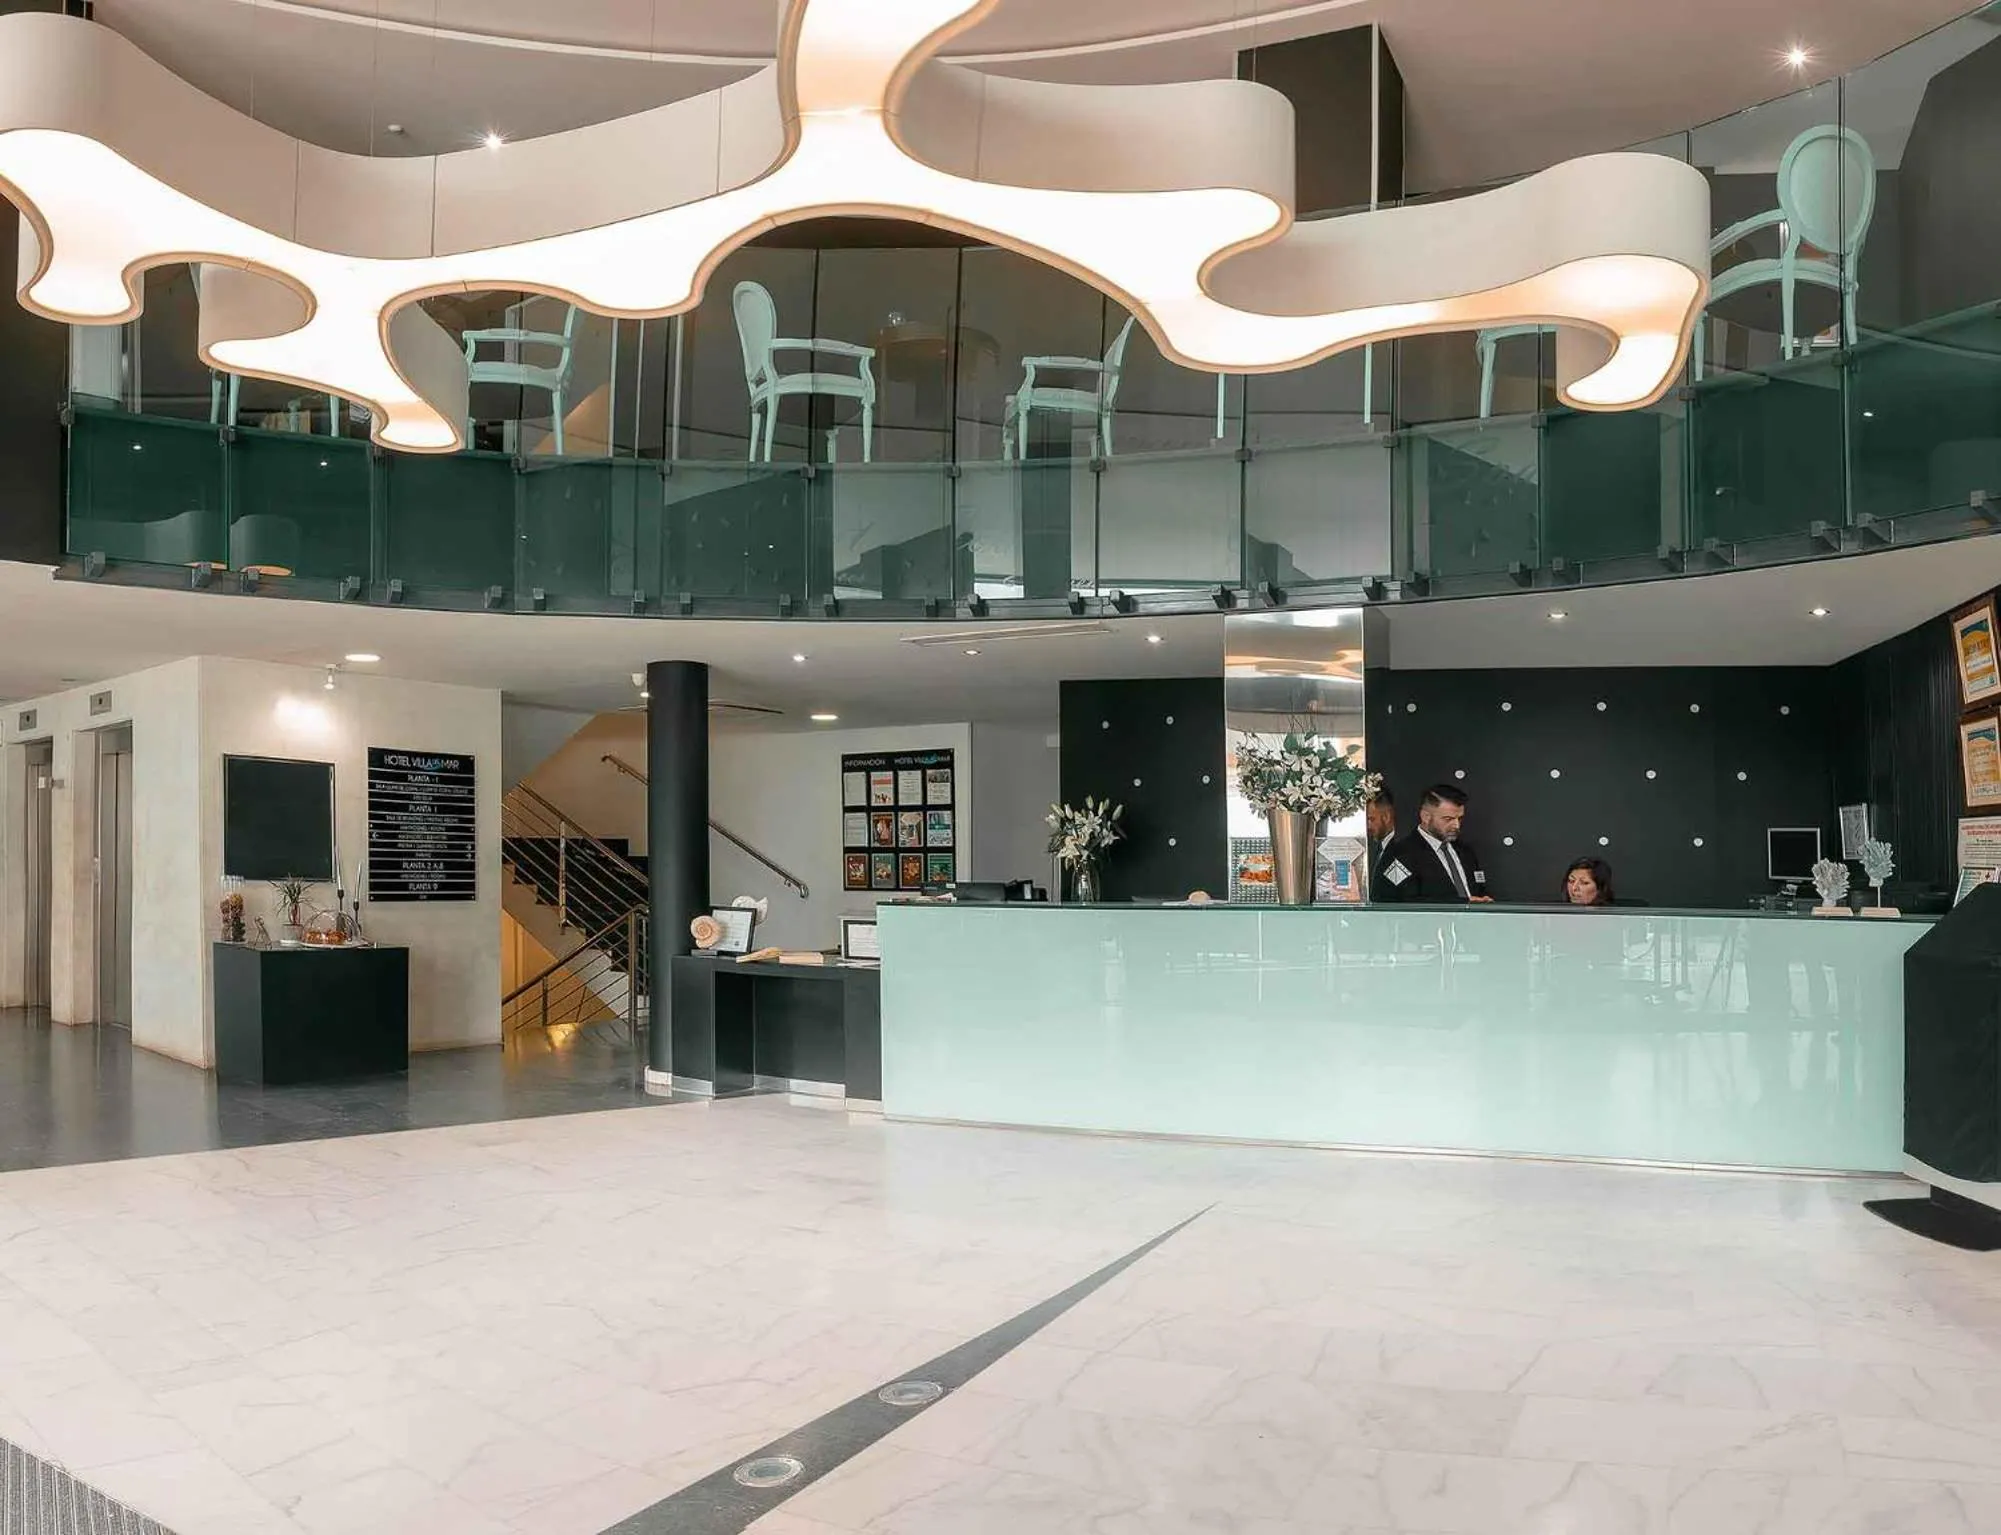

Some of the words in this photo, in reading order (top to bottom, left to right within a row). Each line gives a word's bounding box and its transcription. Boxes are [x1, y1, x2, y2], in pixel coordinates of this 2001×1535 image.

[384, 755, 411, 767] HOTEL
[411, 757, 433, 768] VILLA
[441, 759, 459, 769] MAR
[408, 774, 430, 783] PLANTA
[409, 804, 432, 813] PLANTA
[409, 882, 431, 890] PLANTA
